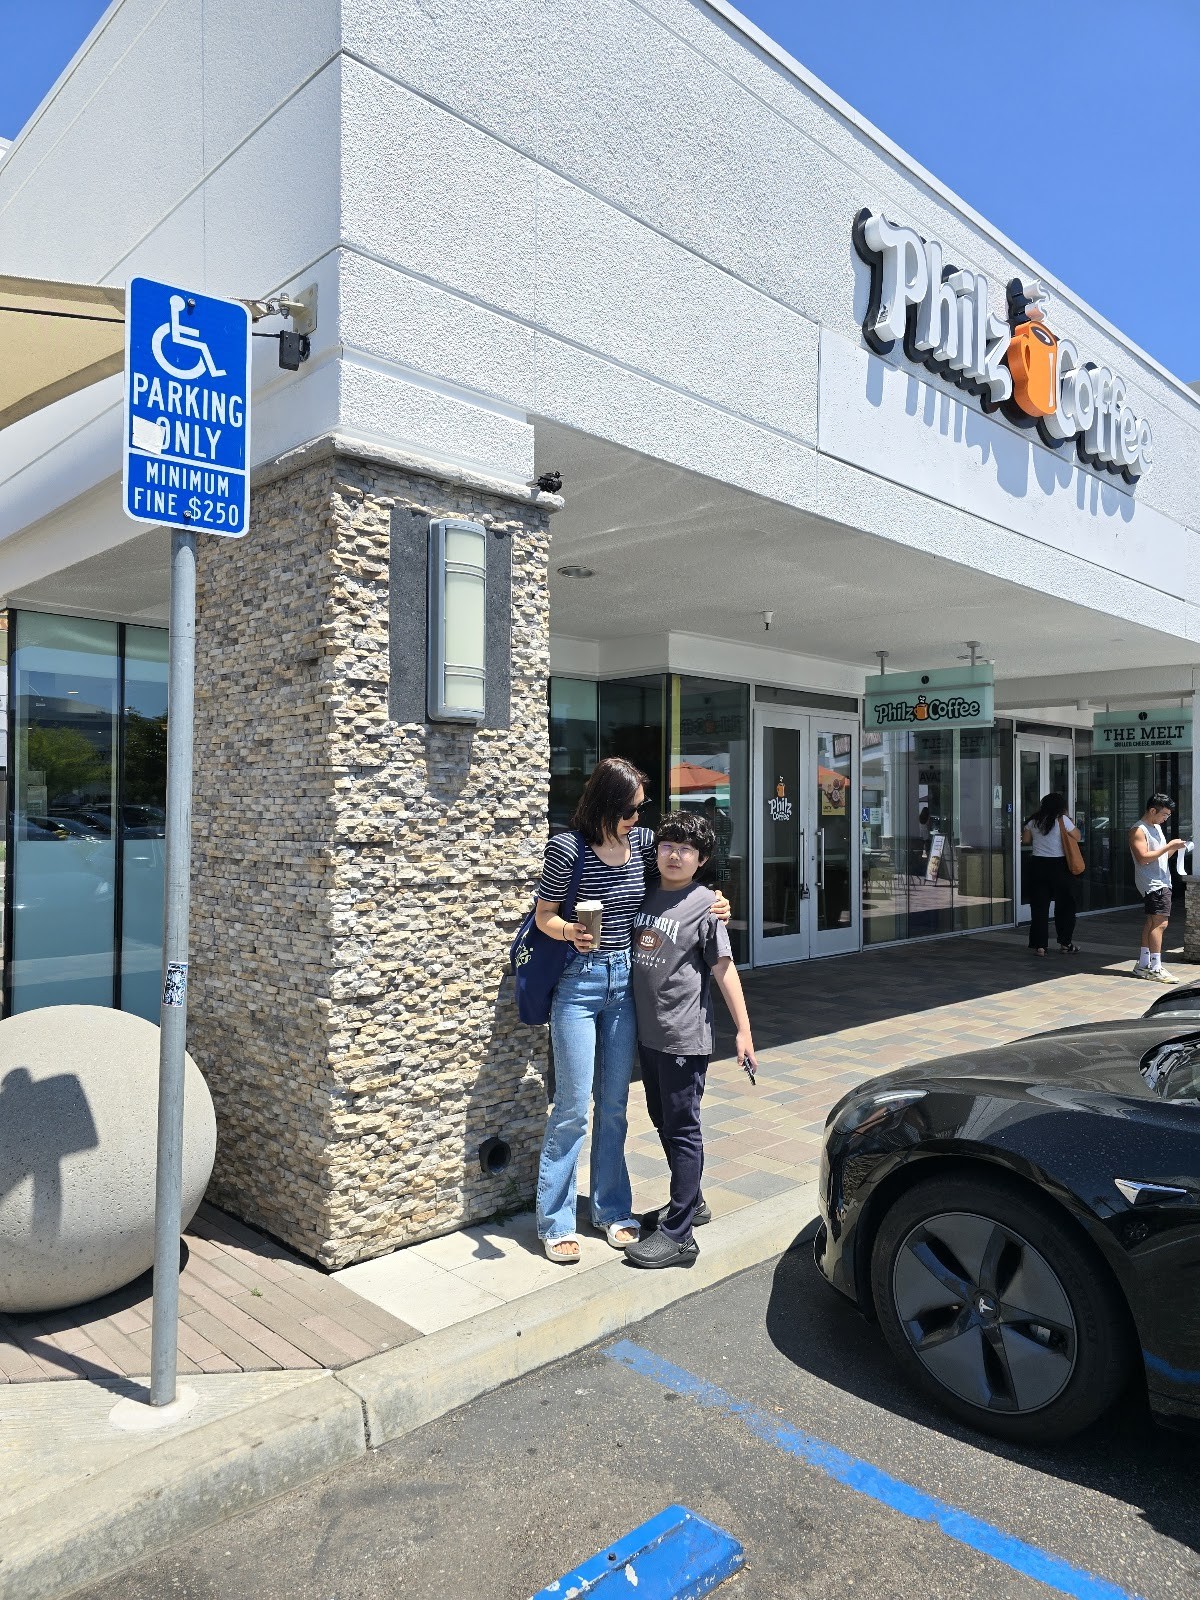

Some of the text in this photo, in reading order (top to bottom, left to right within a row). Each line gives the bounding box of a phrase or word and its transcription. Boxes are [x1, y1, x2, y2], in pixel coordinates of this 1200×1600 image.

[862, 212, 1153, 476] Philz Coffee
[133, 371, 243, 428] PARKING
[146, 460, 229, 498] MINIMUM
[134, 486, 239, 527] FINE $250
[874, 697, 980, 724] Philz Coffee
[1104, 725, 1184, 741] THE MELT
[768, 796, 792, 816] Philz
[634, 912, 680, 944] OLUMBIA
